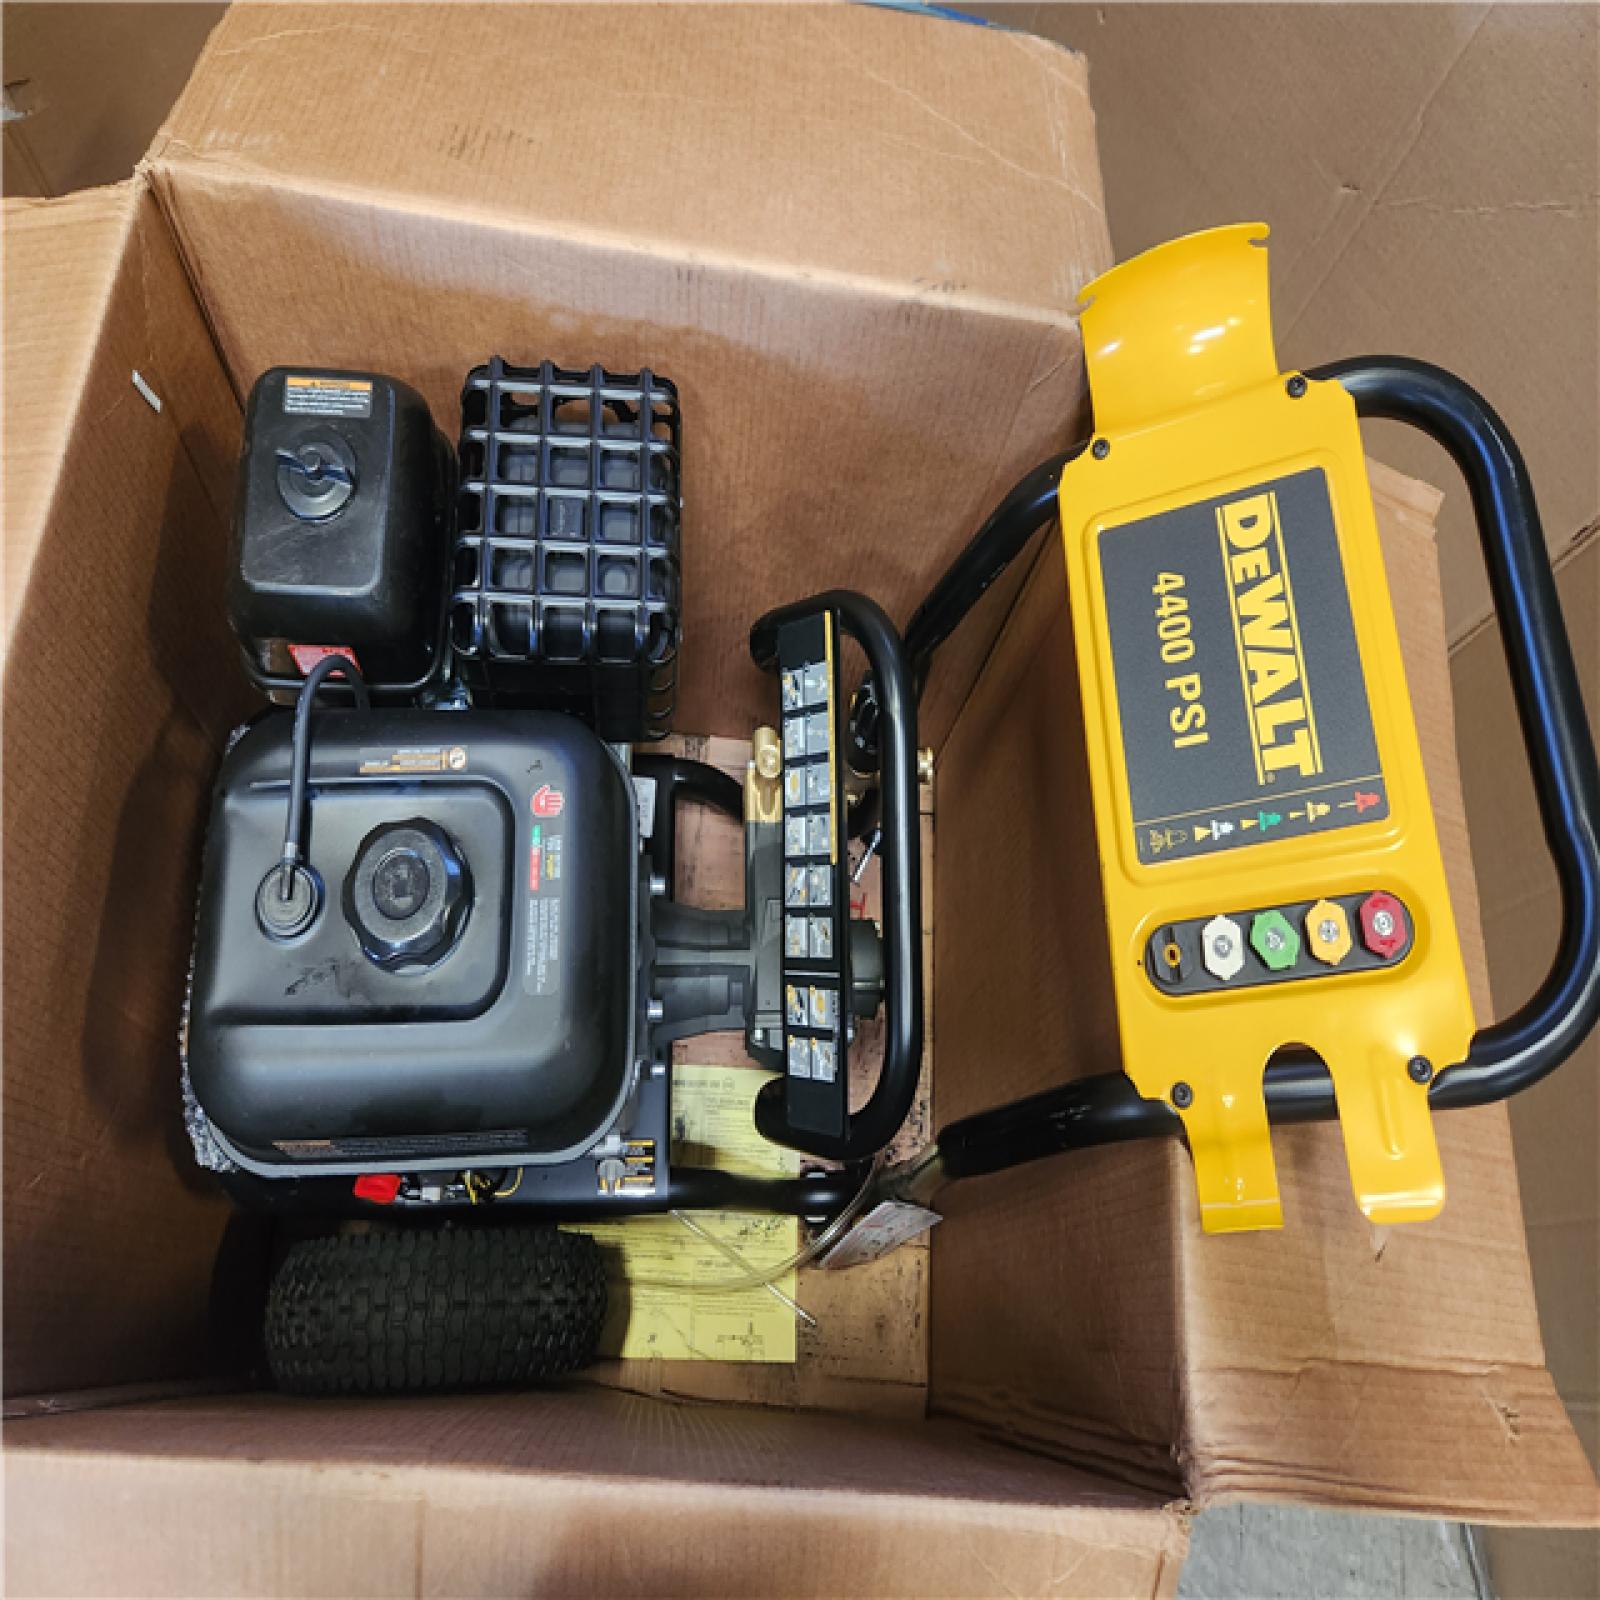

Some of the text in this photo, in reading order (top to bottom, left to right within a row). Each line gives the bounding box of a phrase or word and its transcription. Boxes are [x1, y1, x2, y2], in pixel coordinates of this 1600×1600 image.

[1151, 571, 1209, 749] 4400 PSI
[1219, 491, 1320, 778] DEWALT
